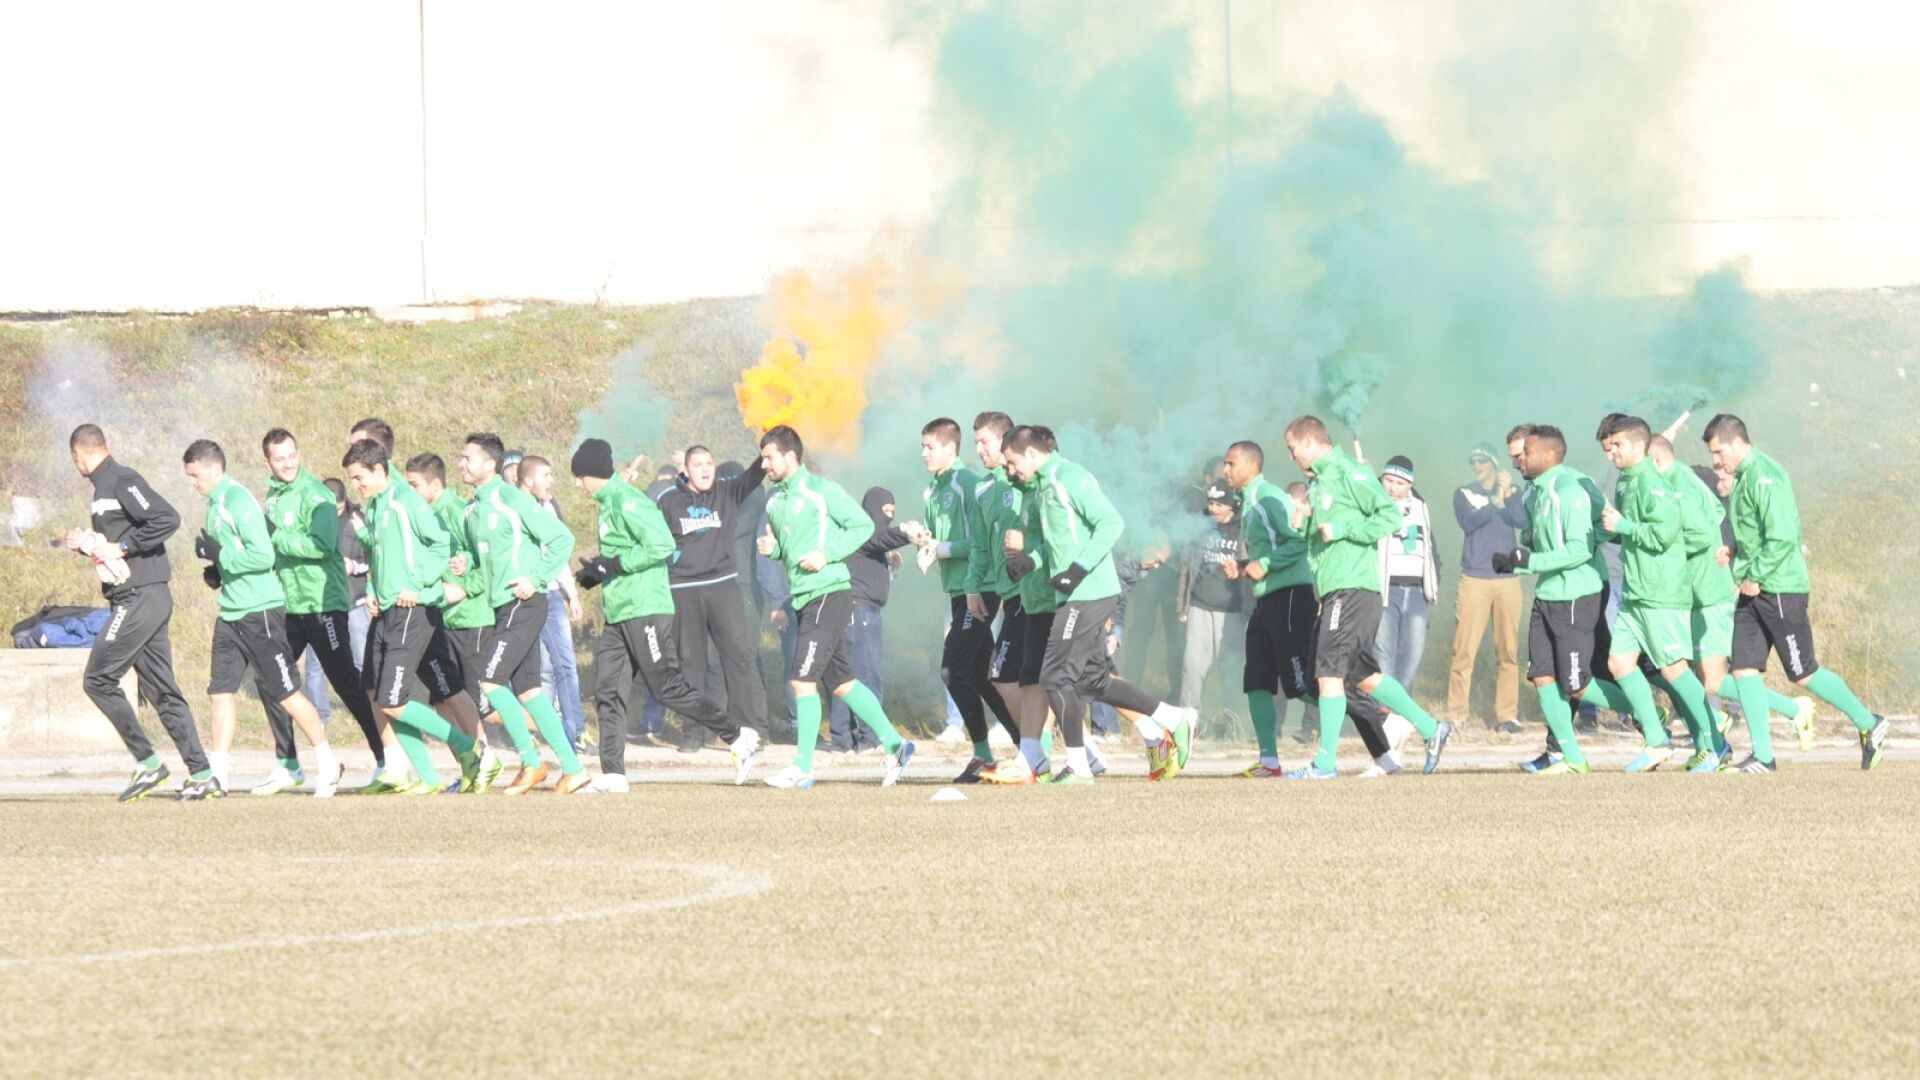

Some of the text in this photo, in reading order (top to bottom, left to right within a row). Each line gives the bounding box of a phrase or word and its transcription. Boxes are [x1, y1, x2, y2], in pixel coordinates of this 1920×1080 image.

[322, 615, 340, 651] Joma
[1062, 607, 1080, 641] Joma
[644, 625, 662, 663] Joma
